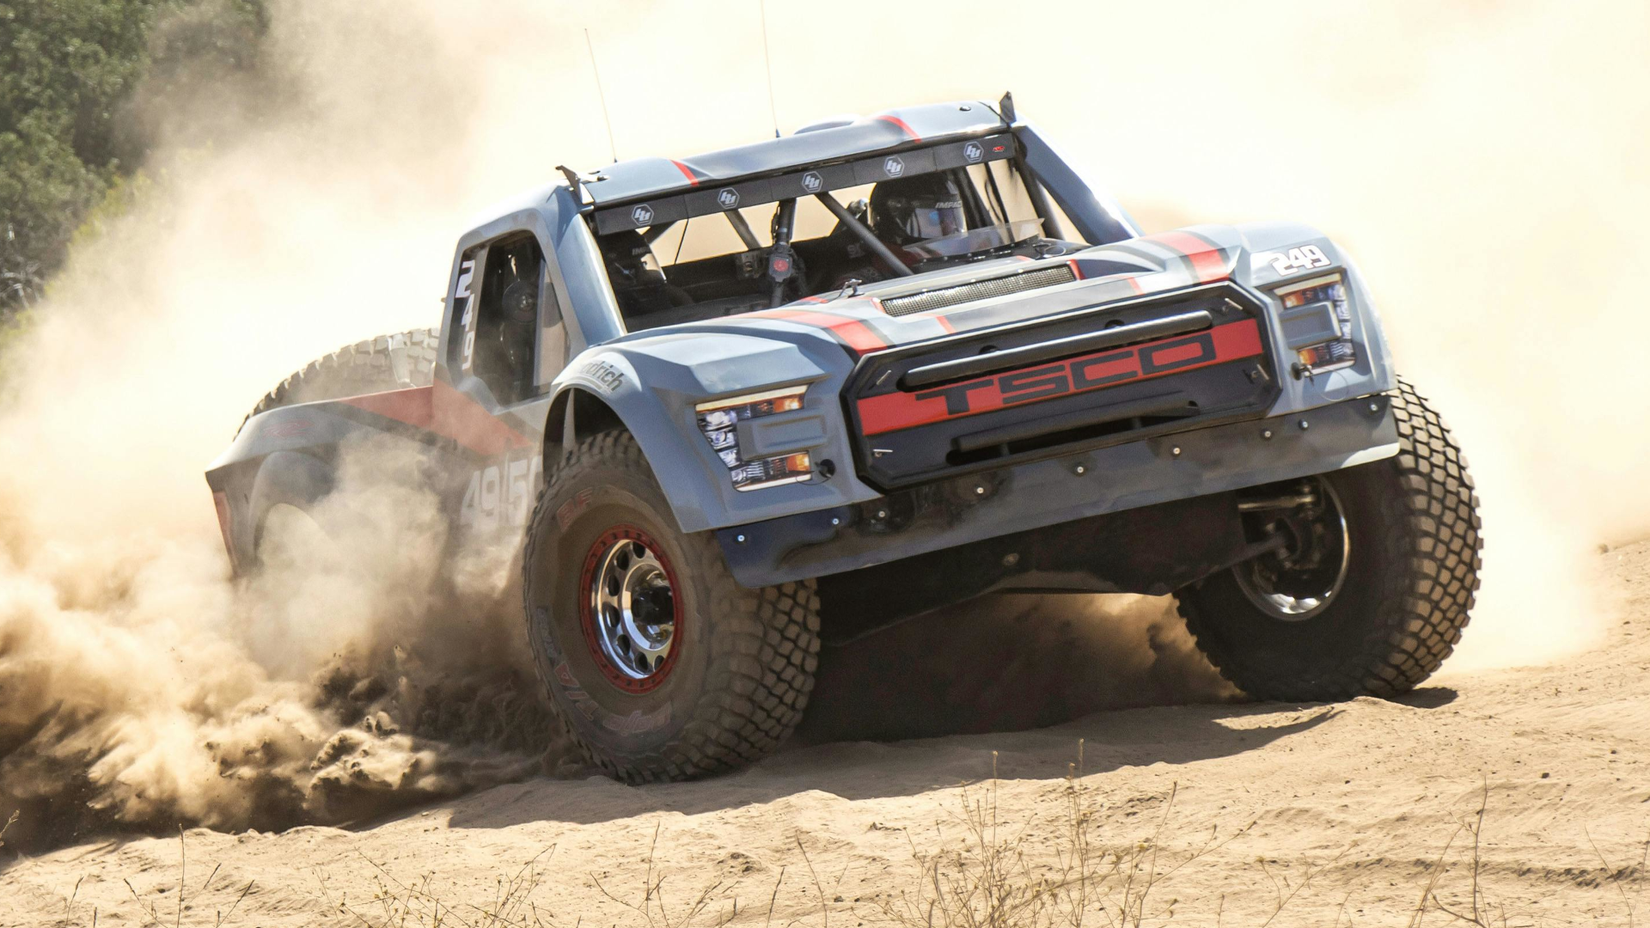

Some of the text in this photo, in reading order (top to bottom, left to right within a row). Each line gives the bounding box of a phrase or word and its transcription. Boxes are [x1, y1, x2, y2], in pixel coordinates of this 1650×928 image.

[1269, 244, 1332, 276] 249
[455, 259, 475, 370] 249
[915, 332, 1217, 416] TSCO
